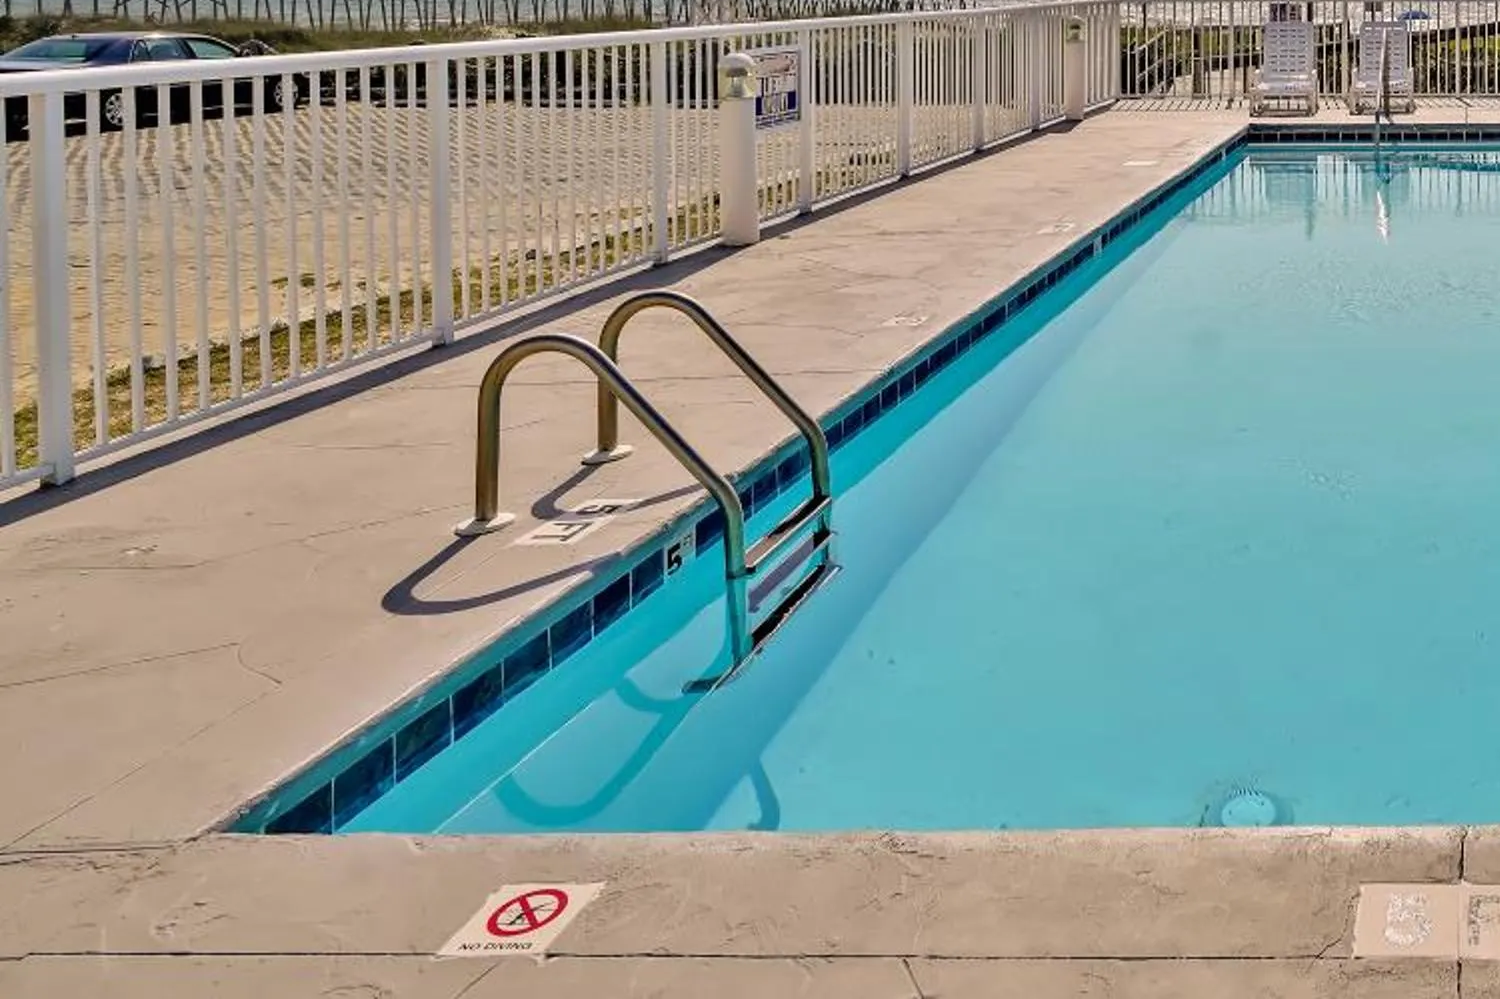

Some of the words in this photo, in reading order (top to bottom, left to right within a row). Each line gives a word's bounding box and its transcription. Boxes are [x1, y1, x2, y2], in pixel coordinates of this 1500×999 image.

[531, 523, 593, 542] FT
[667, 542, 682, 576] 5
[458, 942, 481, 950] NO
